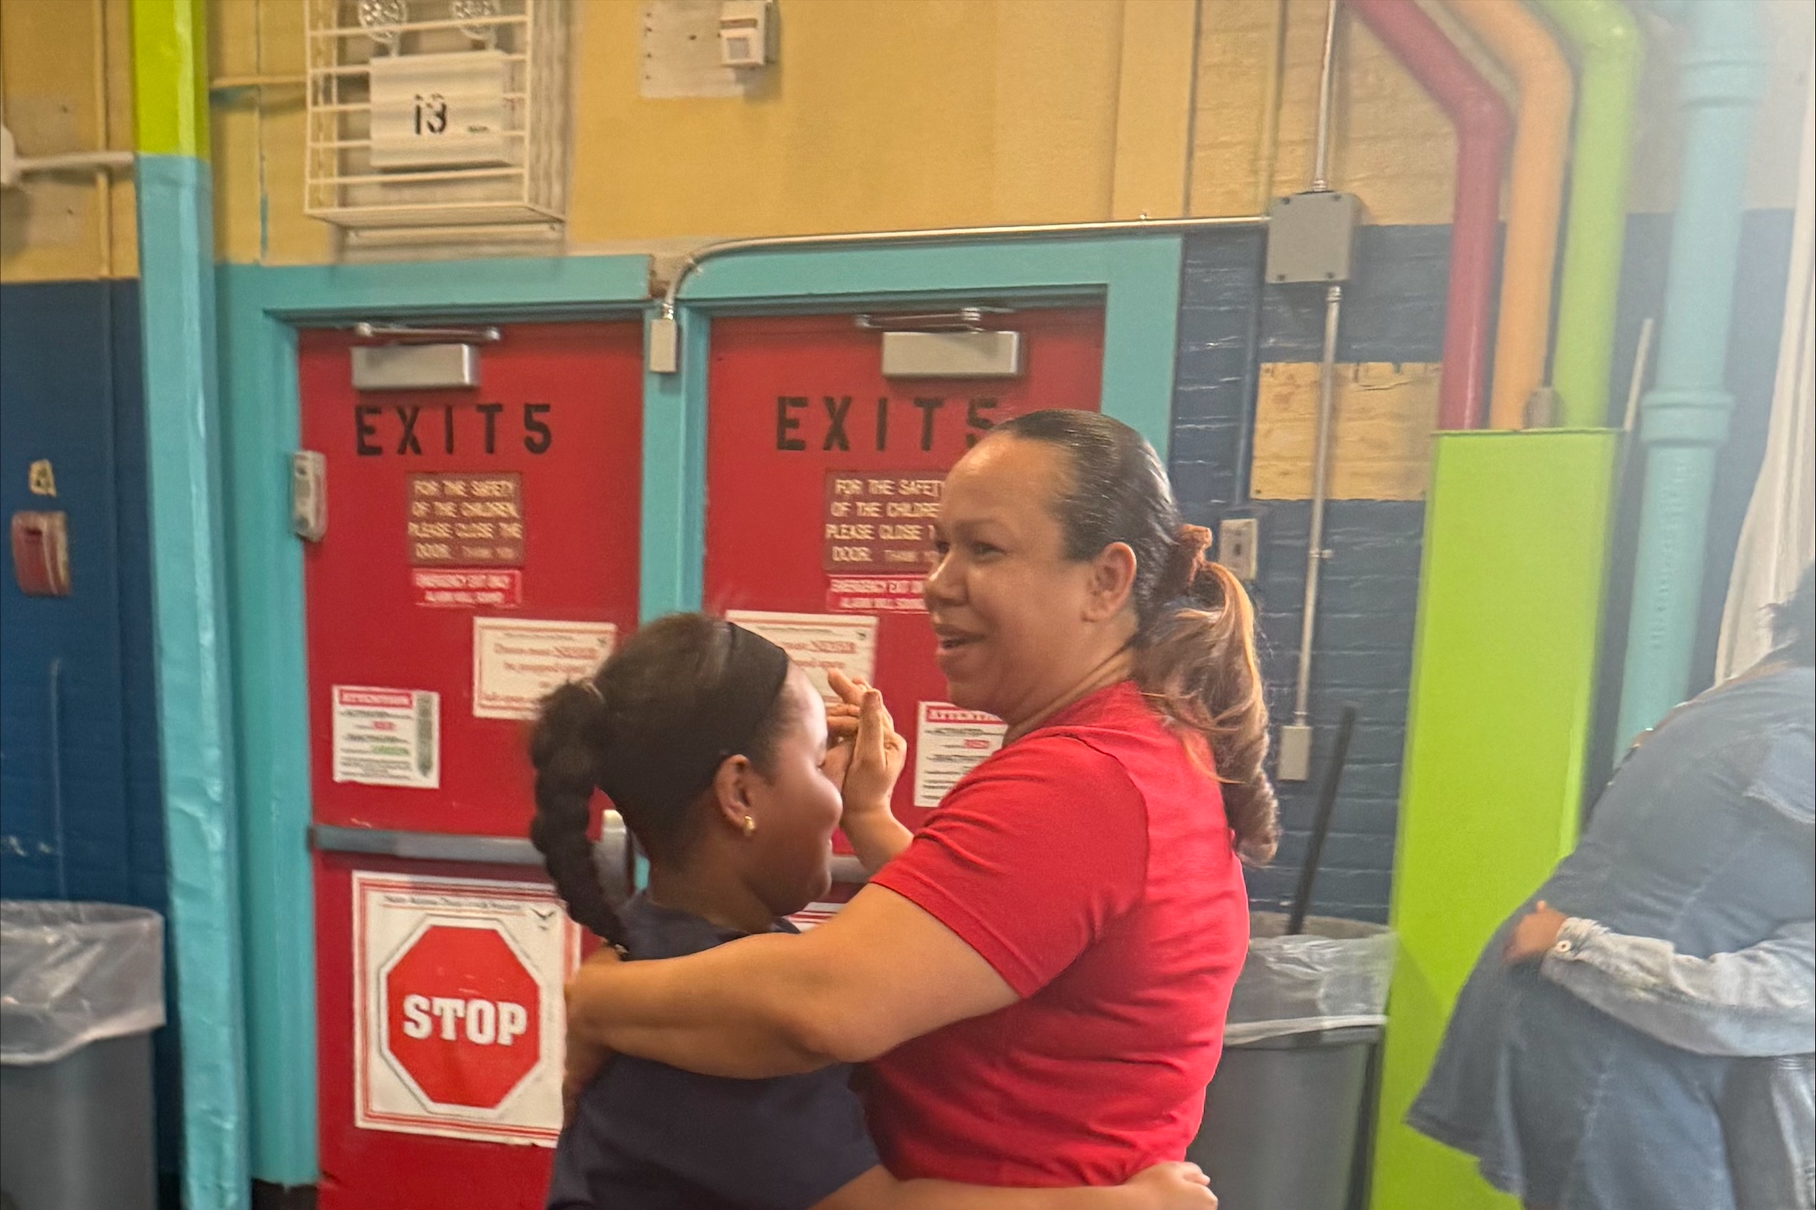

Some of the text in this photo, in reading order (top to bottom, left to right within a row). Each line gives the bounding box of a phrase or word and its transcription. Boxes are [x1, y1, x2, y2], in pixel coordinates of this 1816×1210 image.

[413, 480, 514, 497] FOR THE SAFETY
[835, 479, 863, 495] FOR
[867, 479, 895, 495] THE
[412, 502, 431, 518] OF
[433, 502, 457, 518] THE
[830, 501, 941, 518] OF THE CHILDRE
[408, 522, 522, 539] PLEASE CLOSE THE
[825, 523, 876, 540] PLEASE
[879, 523, 923, 540] CLOSE
[402, 993, 528, 1047] STOP
